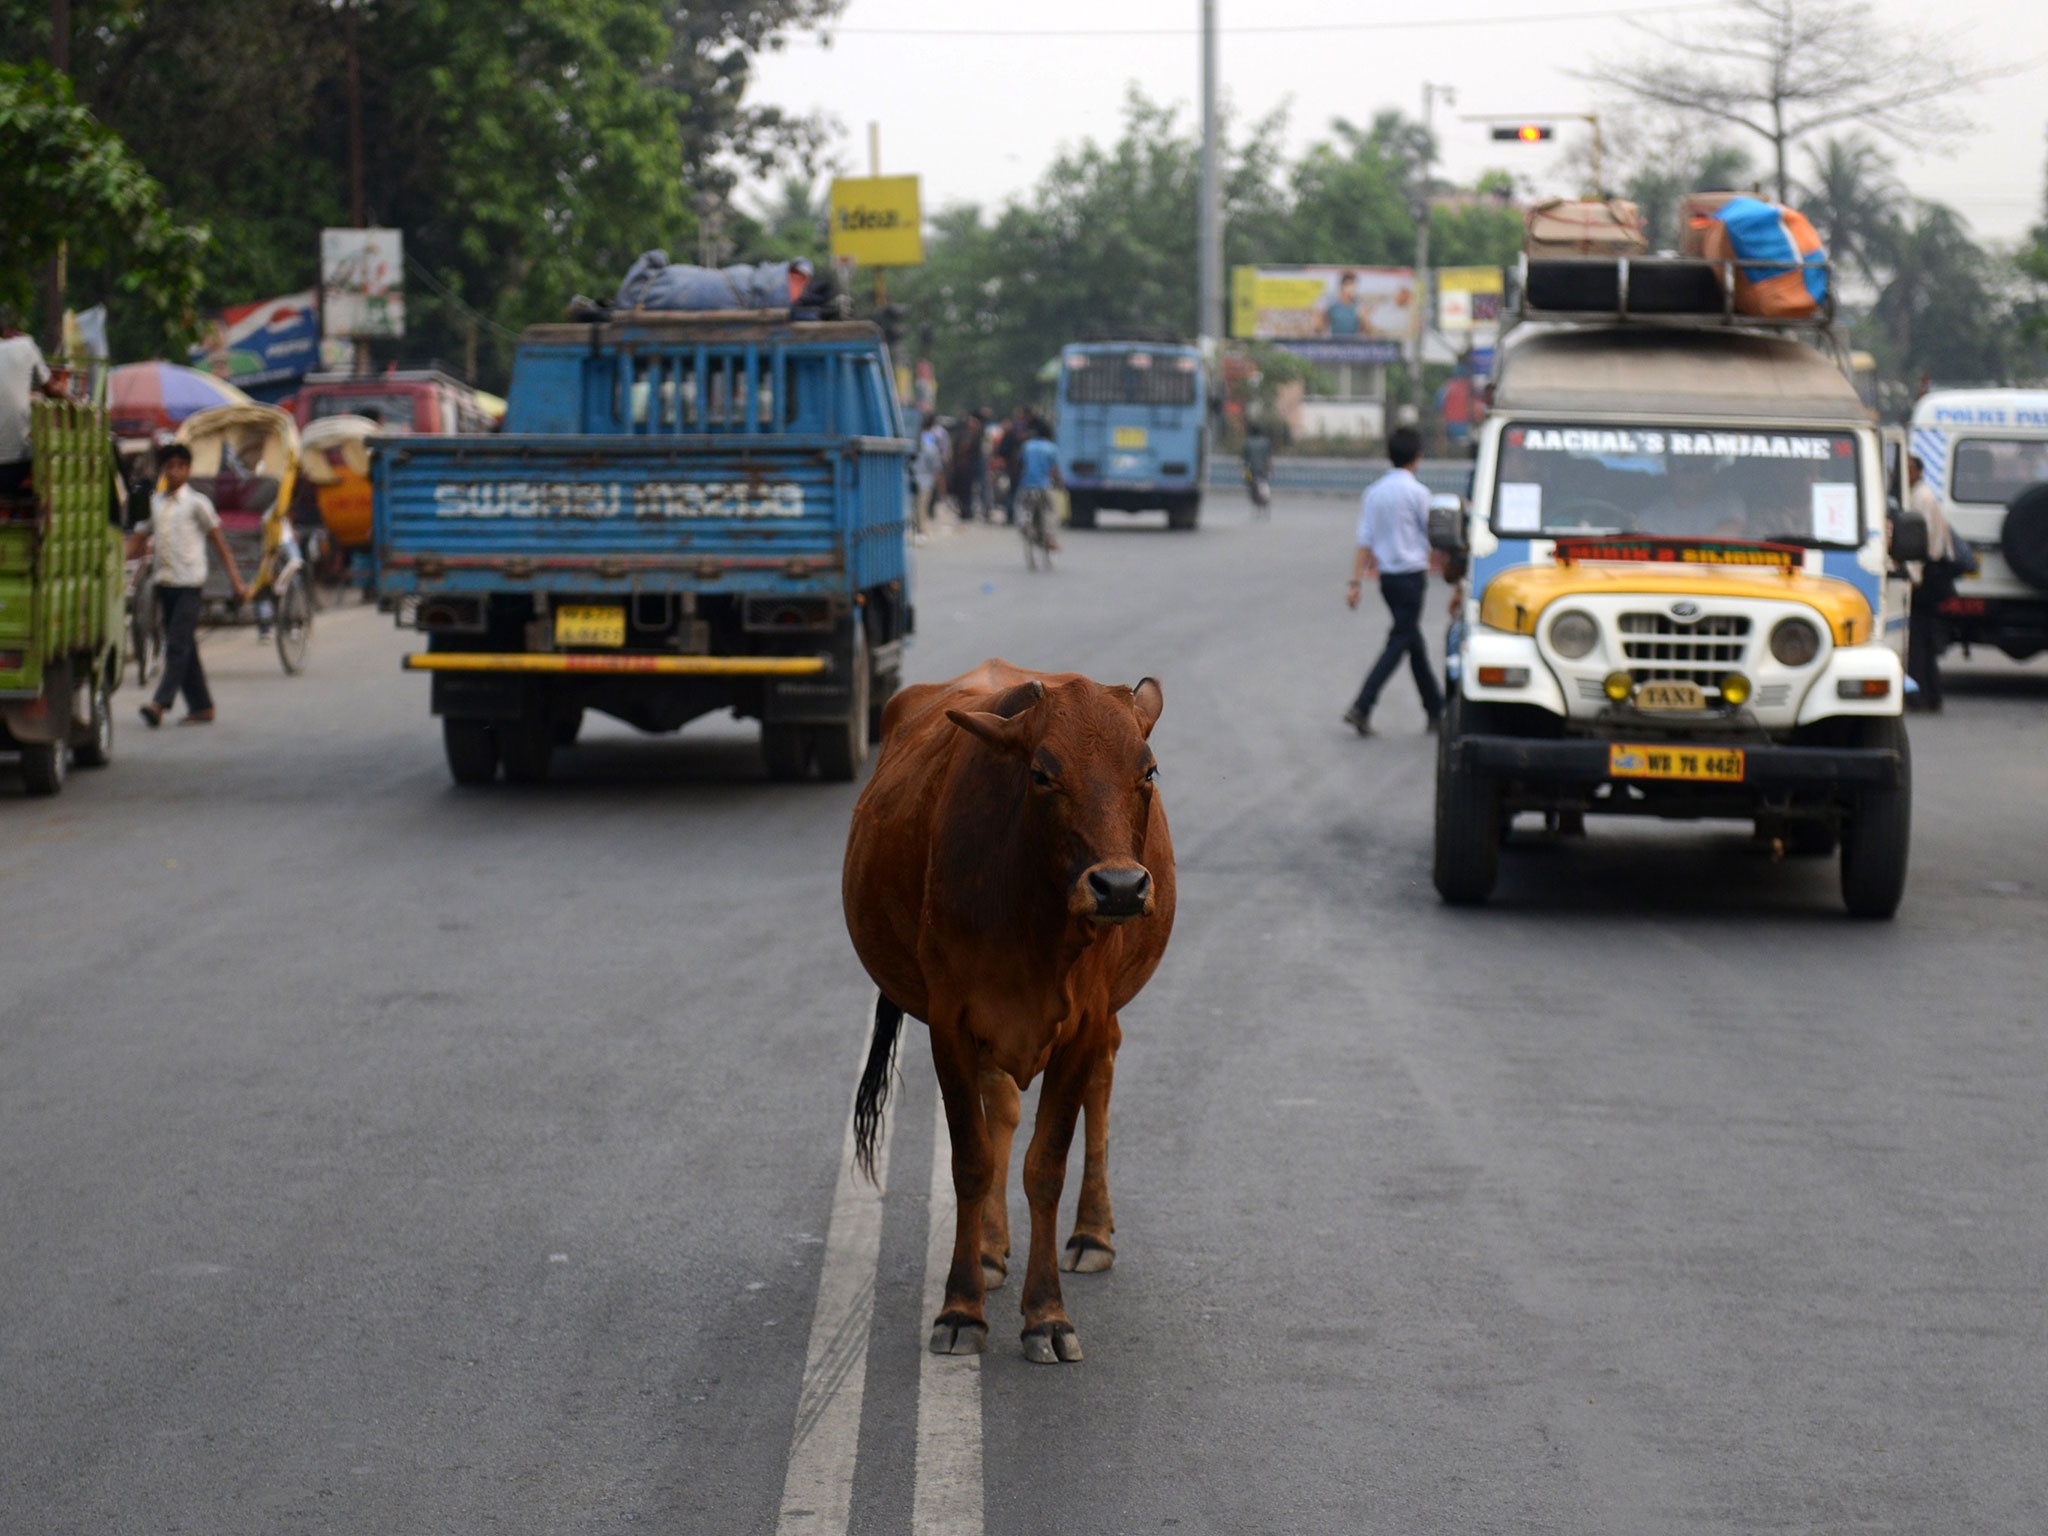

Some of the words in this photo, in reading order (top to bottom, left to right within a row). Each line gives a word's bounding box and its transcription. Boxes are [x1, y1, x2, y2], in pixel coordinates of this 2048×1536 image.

[1524, 429, 1665, 454] AACHAL'S
[1670, 433, 1831, 460] RAMJAANE
[1646, 686, 1696, 705] TAXI
